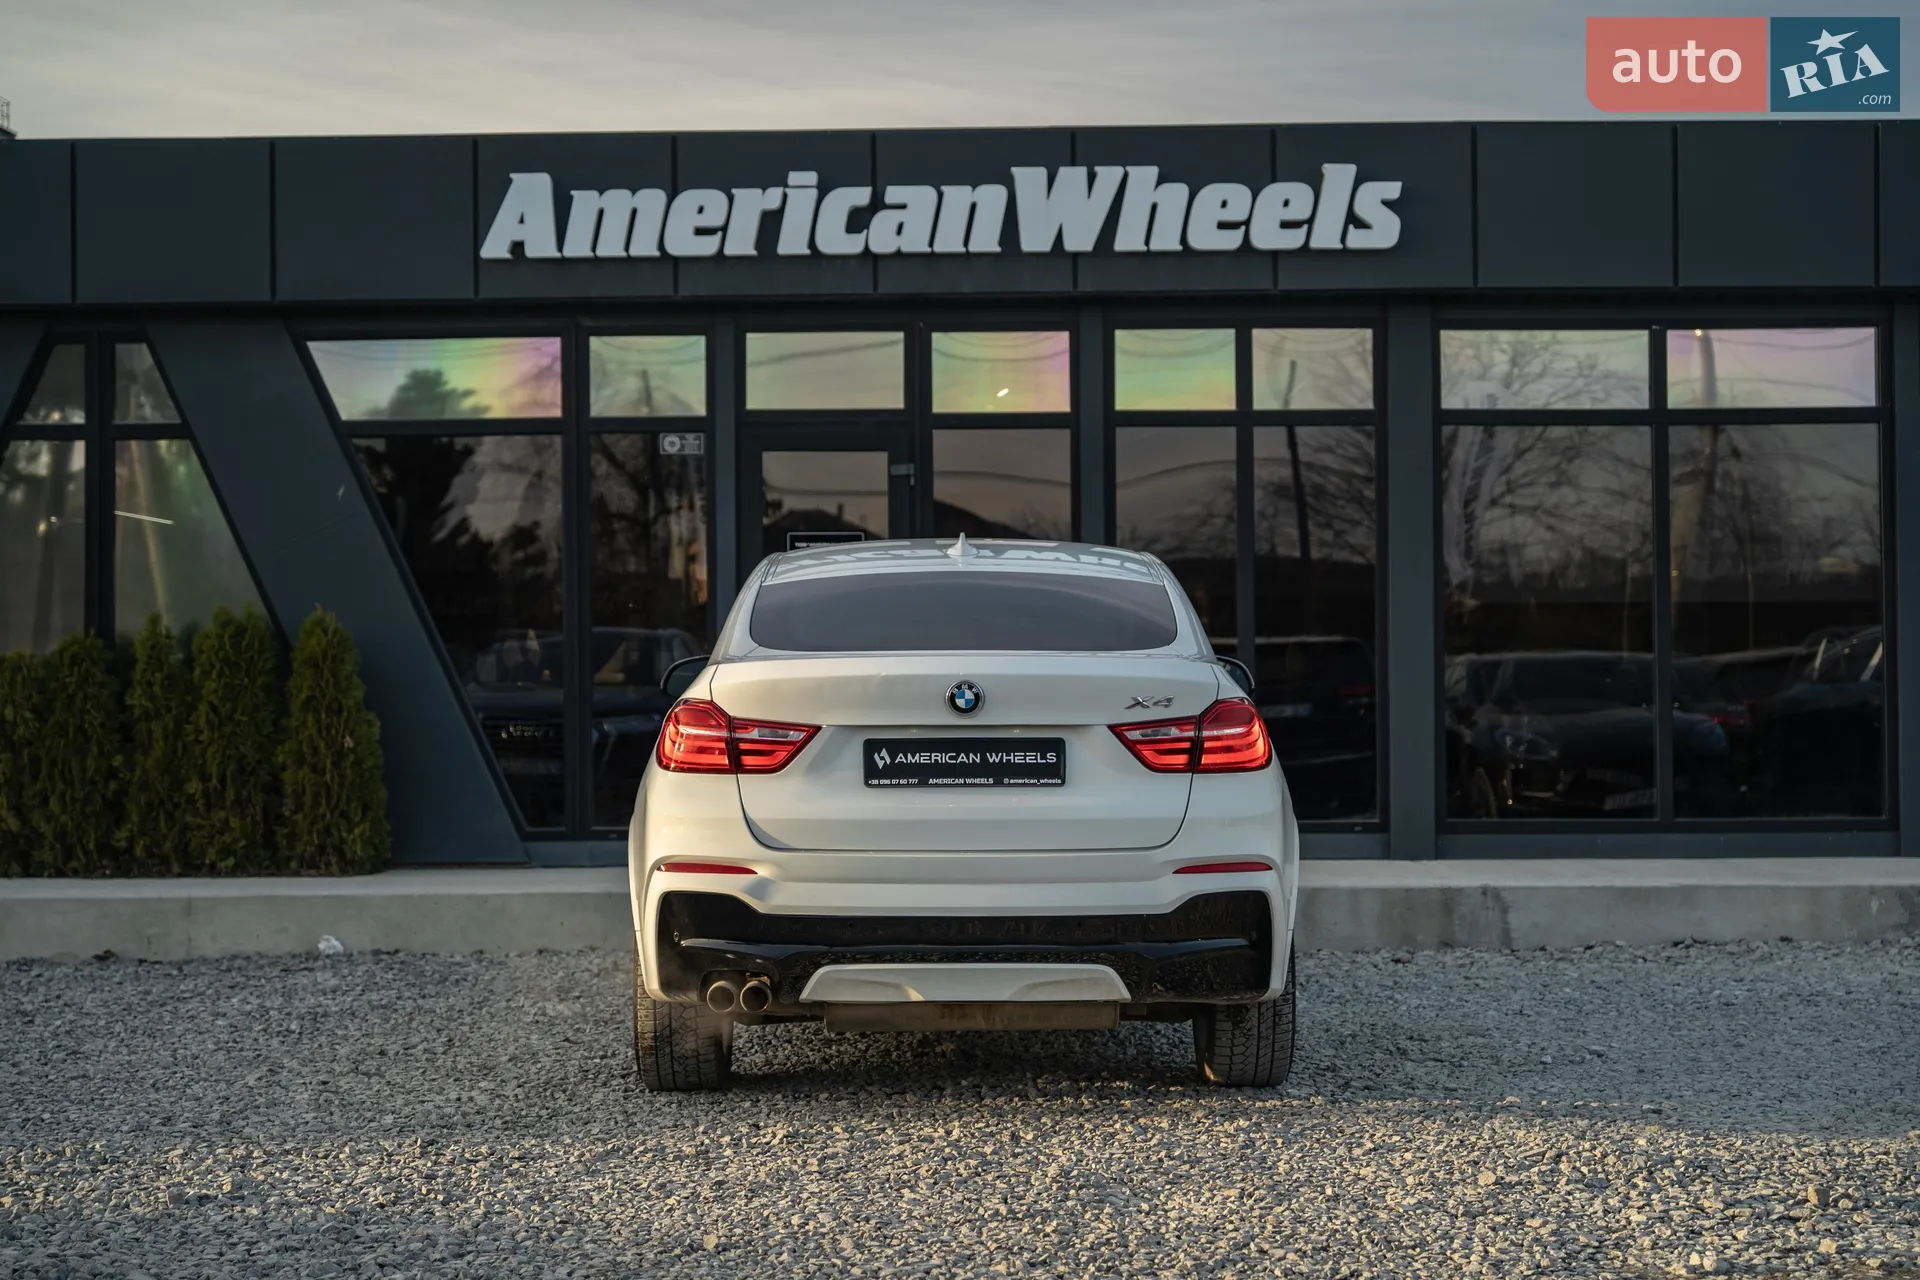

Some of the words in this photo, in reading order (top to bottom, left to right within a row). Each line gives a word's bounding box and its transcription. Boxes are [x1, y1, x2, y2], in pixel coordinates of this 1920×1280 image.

[1123, 695, 1175, 709] X4
[894, 752, 981, 764] AMERICAN
[986, 752, 1057, 764] WHEELS
